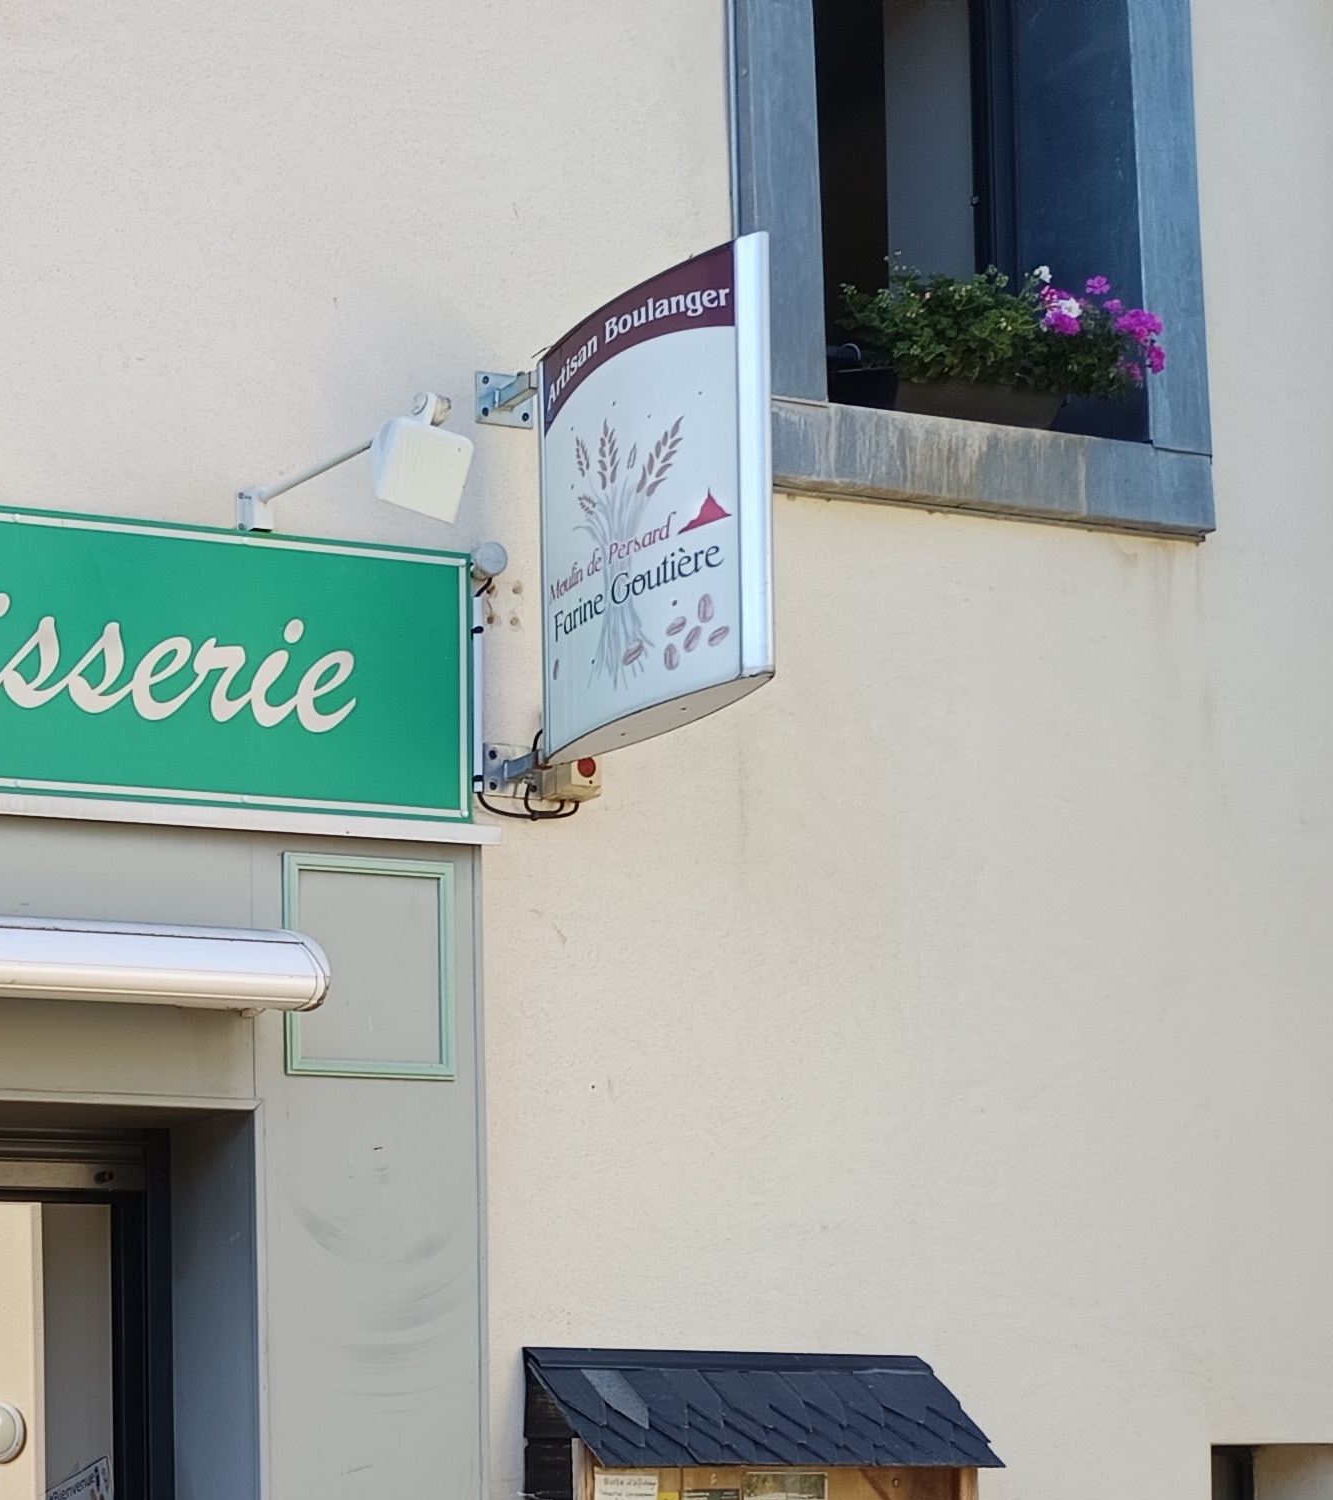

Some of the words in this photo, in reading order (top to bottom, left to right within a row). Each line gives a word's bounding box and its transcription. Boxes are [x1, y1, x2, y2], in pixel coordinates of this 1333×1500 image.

[547, 334, 599, 410] Artisan
[604, 287, 730, 343] Boulanger
[548, 560, 583, 605] Moulin
[587, 549, 603, 576] de
[608, 511, 677, 565] Persard
[554, 593, 605, 642] Farine
[610, 545, 724, 606] Goutière
